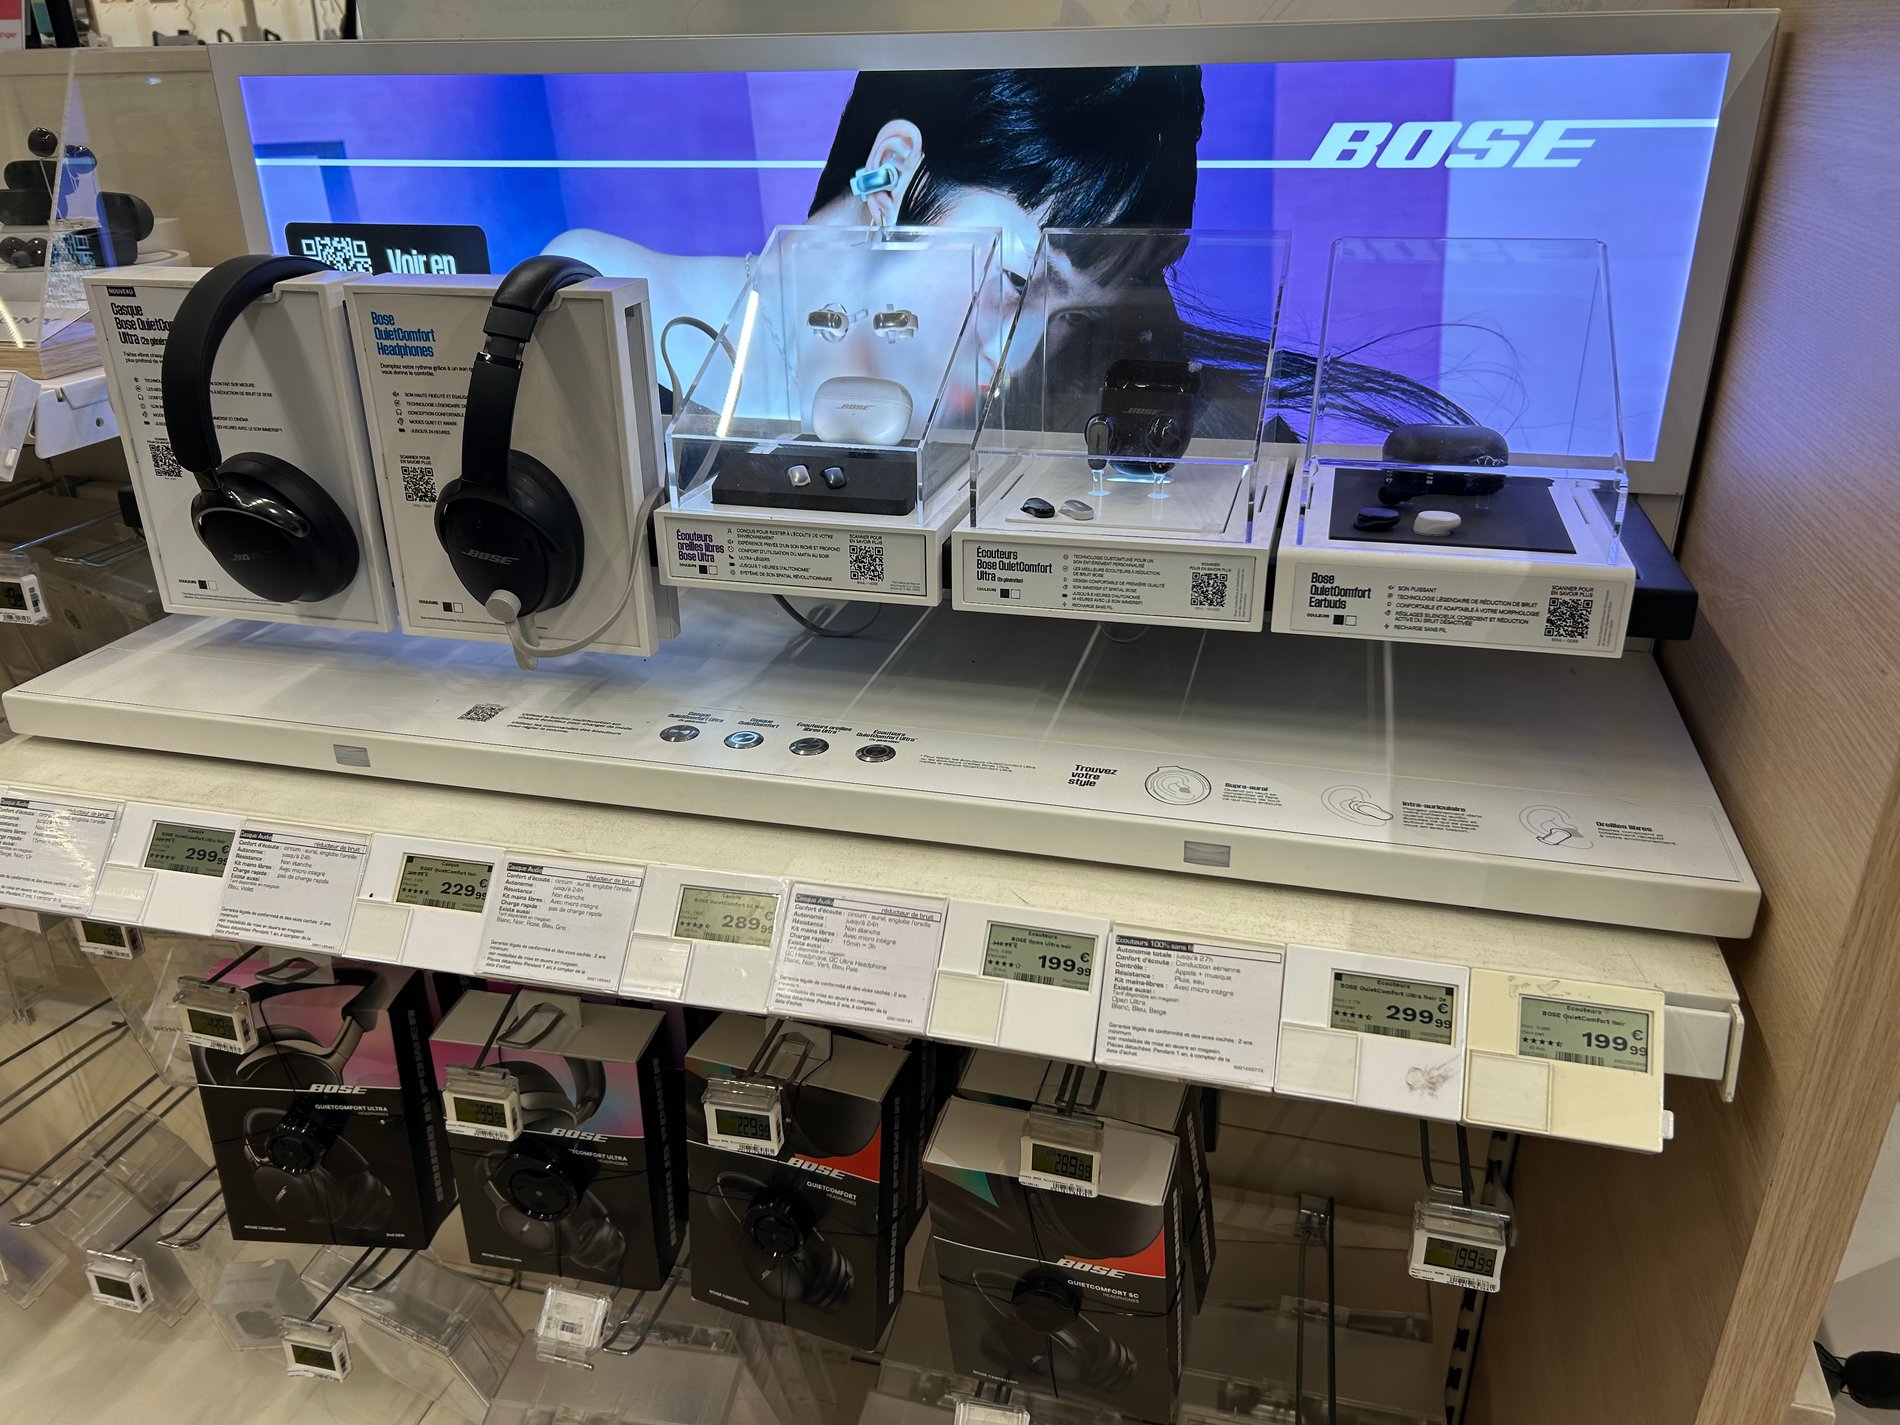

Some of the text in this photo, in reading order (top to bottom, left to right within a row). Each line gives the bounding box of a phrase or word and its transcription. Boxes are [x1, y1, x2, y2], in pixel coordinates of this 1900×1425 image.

[1310, 119, 1597, 169] BOSE
[386, 248, 457, 274] Voir en
[111, 303, 143, 316] Casque
[115, 317, 174, 332] Bose QuietCo
[370, 311, 395, 326] Bose
[118, 332, 139, 344] Ultra
[374, 327, 436, 342] QuietComfort
[377, 342, 434, 358] Headphones
[1124, 407, 1163, 415] BOSE
[676, 529, 713, 543] Écouteurs
[677, 541, 724, 553] oreilles libres
[976, 546, 1018, 560] Écouteurs
[462, 549, 517, 565] BOSE
[678, 551, 715, 562] Bose Ultra
[977, 559, 1052, 574] Bose QuietComfort
[977, 571, 996, 582] Ultra
[1311, 572, 1335, 584] Bose
[1310, 584, 1372, 599] QuietComfort
[1309, 596, 1346, 609] Earbuds
[1396, 602, 1435, 610] CONFORTABLE
[1436, 596, 1470, 604] LÉGENDAIRE
[1480, 598, 1511, 606] RÉDUCTION
[1075, 764, 1118, 775] Trouvez
[1071, 772, 1100, 780] votre
[1068, 778, 1097, 787] style
[1225, 783, 1268, 791] Supra-aural
[1402, 801, 1466, 812] Intra-auriculaire
[258, 832, 272, 840] Audio
[507, 863, 527, 872] Casque
[795, 895, 834, 906] Casque Audio
[1116, 936, 1149, 947] Ecouteurs
[1150, 940, 1170, 949] 100%
[1116, 946, 1151, 956] Autonomie
[1116, 954, 1141, 962] Confort
[1142, 957, 1170, 966] d'écoute
[1175, 960, 1211, 970] Conduction
[1115, 961, 1232, 981] Contrôle Appels musique
[1115, 969, 1151, 979] Résistance
[1376, 980, 1410, 989] Ecouteurs
[1191, 985, 1210, 993] micro
[1211, 987, 1234, 997] intégré
[1112, 996, 1146, 1006] Open Ultra
[1149, 1007, 1167, 1016] Beige
[1567, 1005, 1602, 1015] Ecouteurs
[1542, 1010, 1561, 1018] BOSE
[1563, 1013, 1610, 1024] QuietComfort
[308, 1084, 367, 1094] BOSE
[551, 1128, 608, 1142] BOSE
[787, 1157, 845, 1180] BOSE
[807, 1181, 857, 1200] QUIETCOMFORT
[827, 1193, 857, 1206] HEADPHONES
[1056, 1258, 1126, 1279] BOSE
[1068, 1279, 1127, 1296] QUIETCOMFORT
[1103, 1293, 1139, 1303] HEADPHONES
